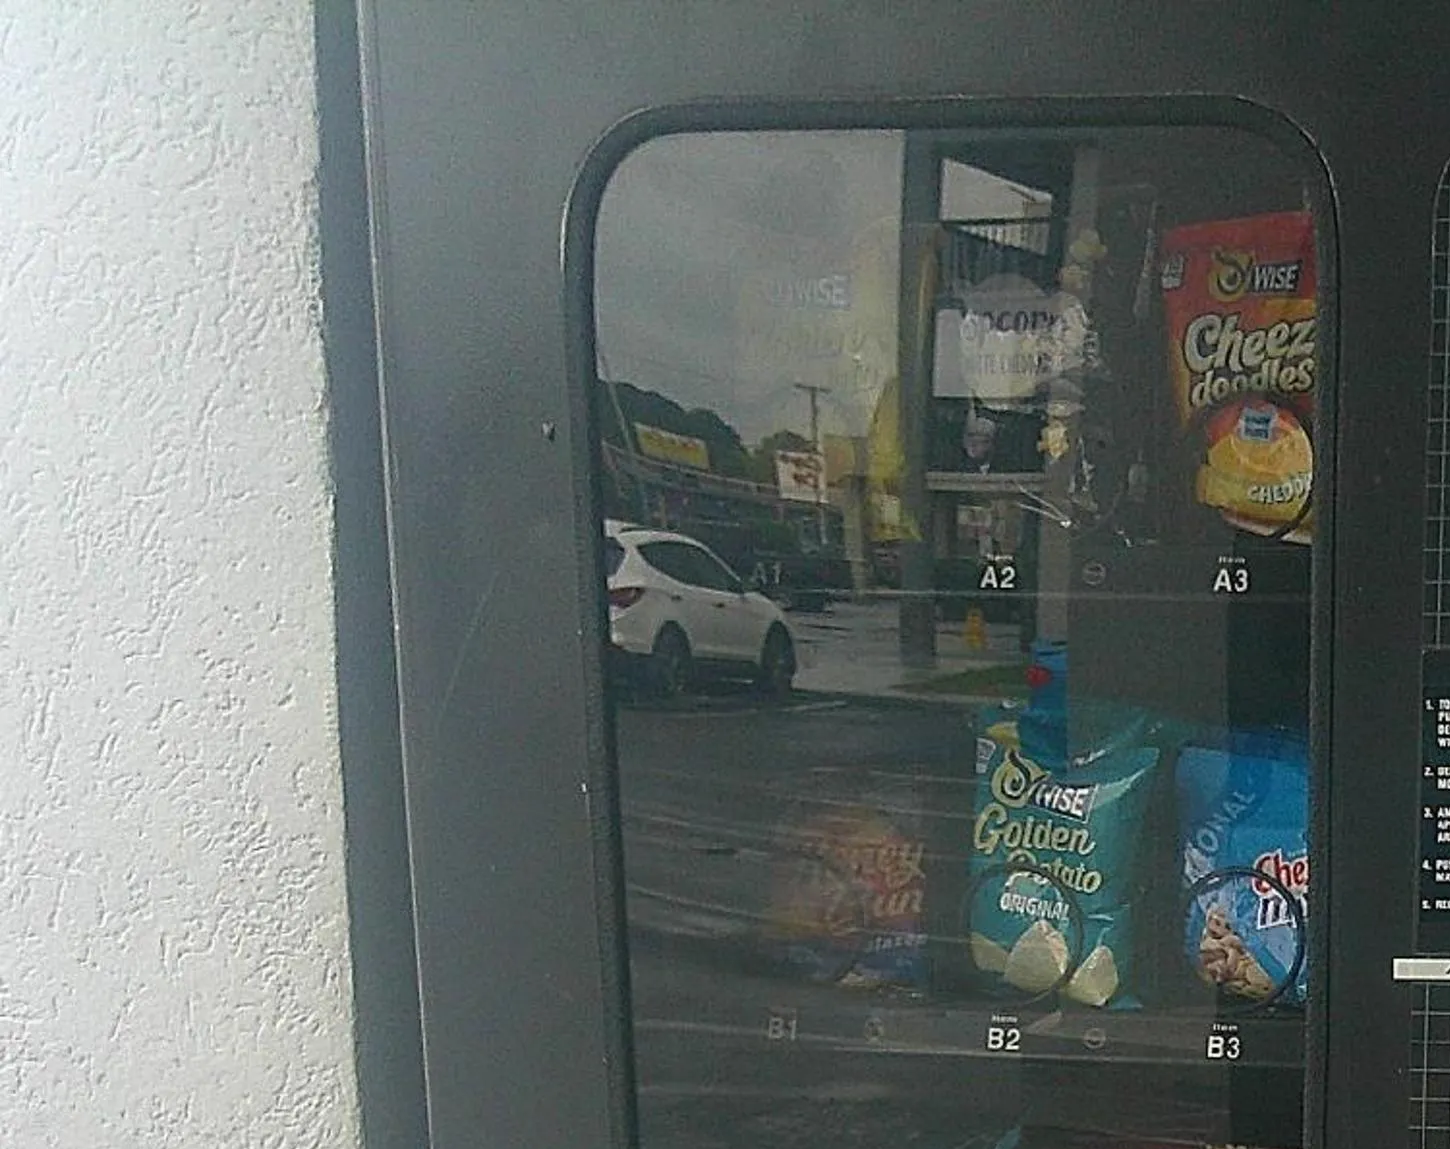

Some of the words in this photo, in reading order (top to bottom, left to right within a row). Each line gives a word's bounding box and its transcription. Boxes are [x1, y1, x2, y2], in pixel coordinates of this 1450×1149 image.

[1254, 265, 1299, 290] WISE
[1184, 313, 1316, 373] Cheez
[1191, 356, 1314, 408] doodles
[980, 566, 1015, 590] A2
[1213, 568, 1248, 592] A3
[1034, 783, 1089, 816] WISE
[974, 802, 1096, 856] Golden
[1007, 849, 1102, 894] Ptato
[987, 1027, 1021, 1051] B2
[1206, 1035, 1240, 1060] B3
